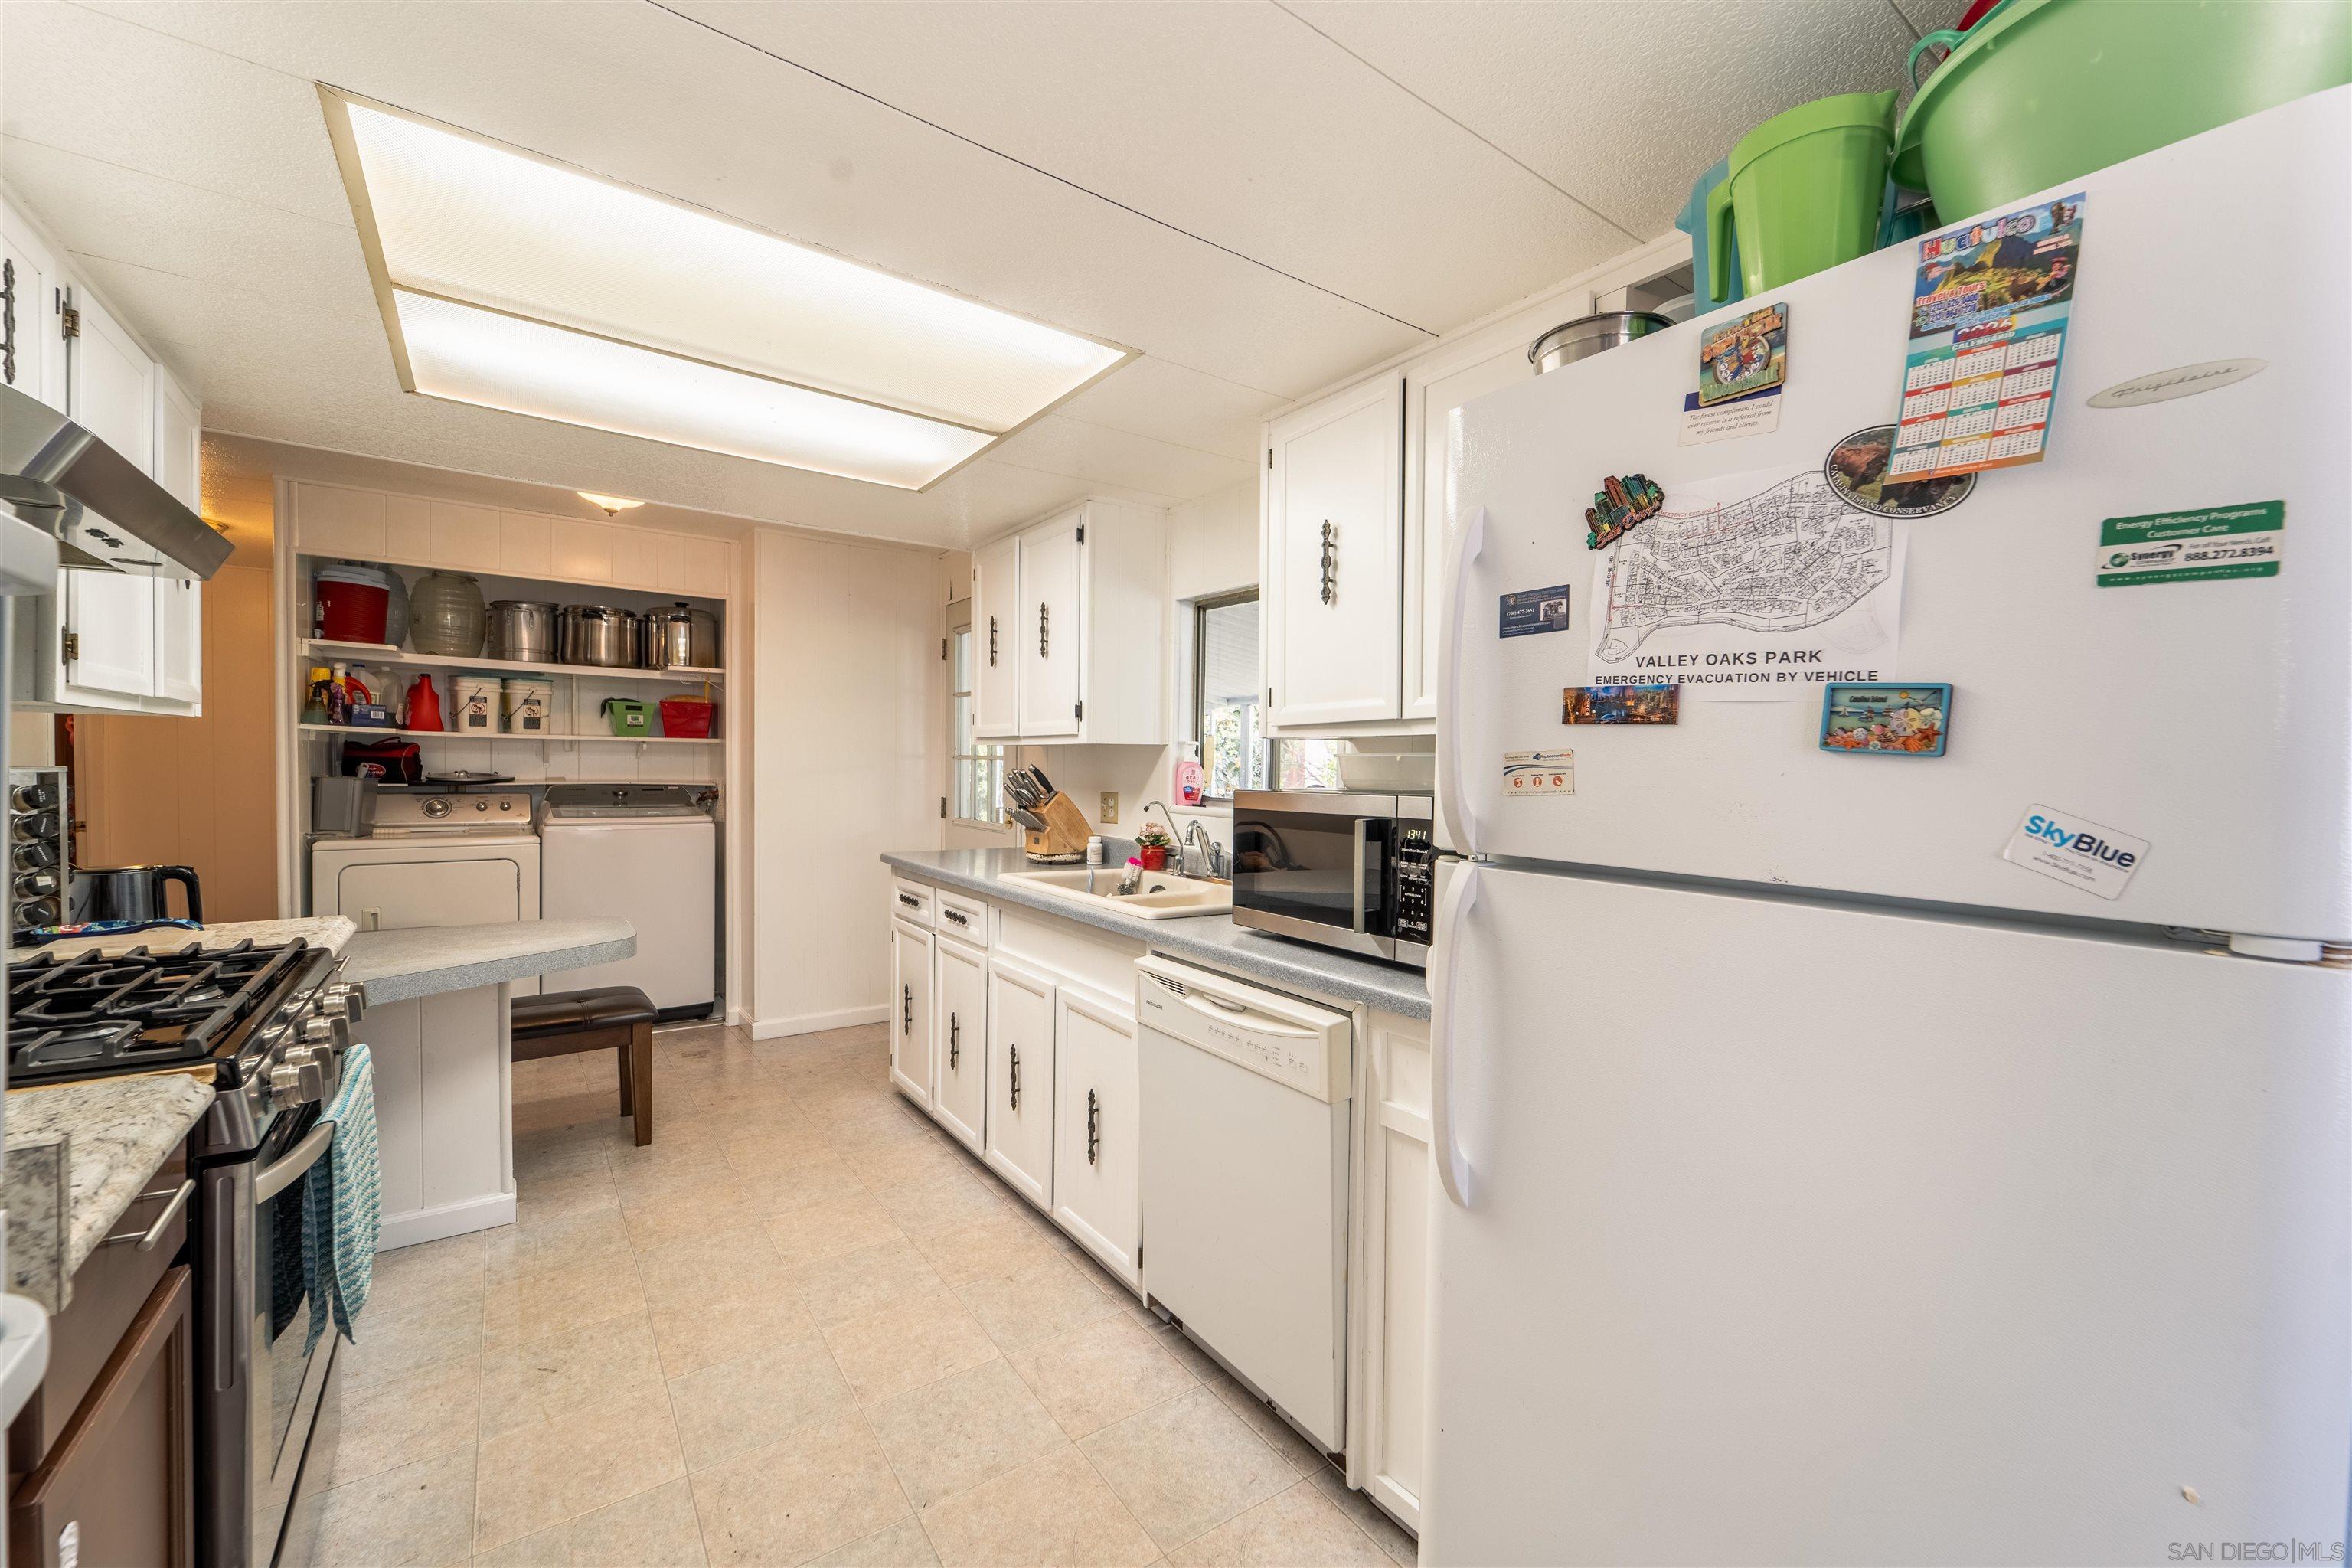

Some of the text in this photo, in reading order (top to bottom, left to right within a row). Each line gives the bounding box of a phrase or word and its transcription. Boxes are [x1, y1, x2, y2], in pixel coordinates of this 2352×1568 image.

[1952, 332, 2016, 350] CALENDARIO
[1700, 411, 1717, 420] finest
[1717, 406, 1751, 416] compliment
[1755, 400, 1774, 410] could
[1700, 419, 1721, 427] receive
[1733, 412, 1756, 422] referral
[1756, 410, 1772, 420] from
[1704, 425, 1725, 436] friends
[1851, 493, 1883, 511] ISLAND
[1883, 495, 1958, 514] CONSERVANCY
[2115, 508, 2267, 531] Energy Efficiency Programs
[2146, 524, 2230, 538] Customer Care
[1609, 555, 1614, 564] RD
[2131, 550, 2176, 561] Synergy
[2184, 545, 2275, 562] 888.272.8394
[1635, 649, 1824, 668] VALLEY OAKS PARK
[1595, 670, 1879, 685] EMERGENCY EVACUATION BY VEHICLE
[2024, 815, 2135, 867] SkyBlue
